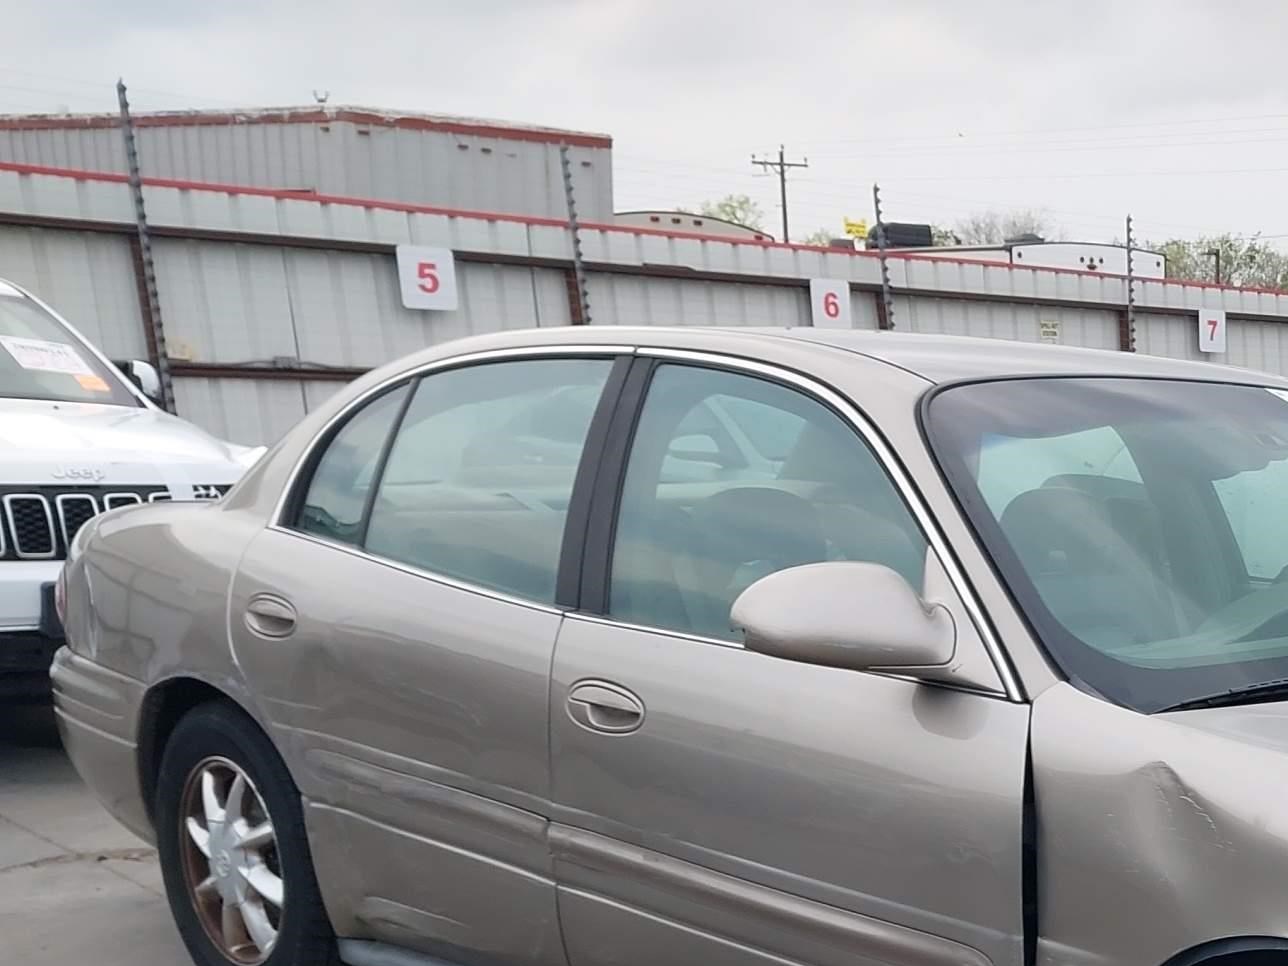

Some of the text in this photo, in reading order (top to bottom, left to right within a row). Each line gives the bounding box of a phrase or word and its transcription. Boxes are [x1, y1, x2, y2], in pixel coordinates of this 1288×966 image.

[417, 262, 440, 293] 5
[824, 291, 840, 319] 6
[1207, 319, 1218, 341] 7
[51, 464, 105, 483] Jeep
